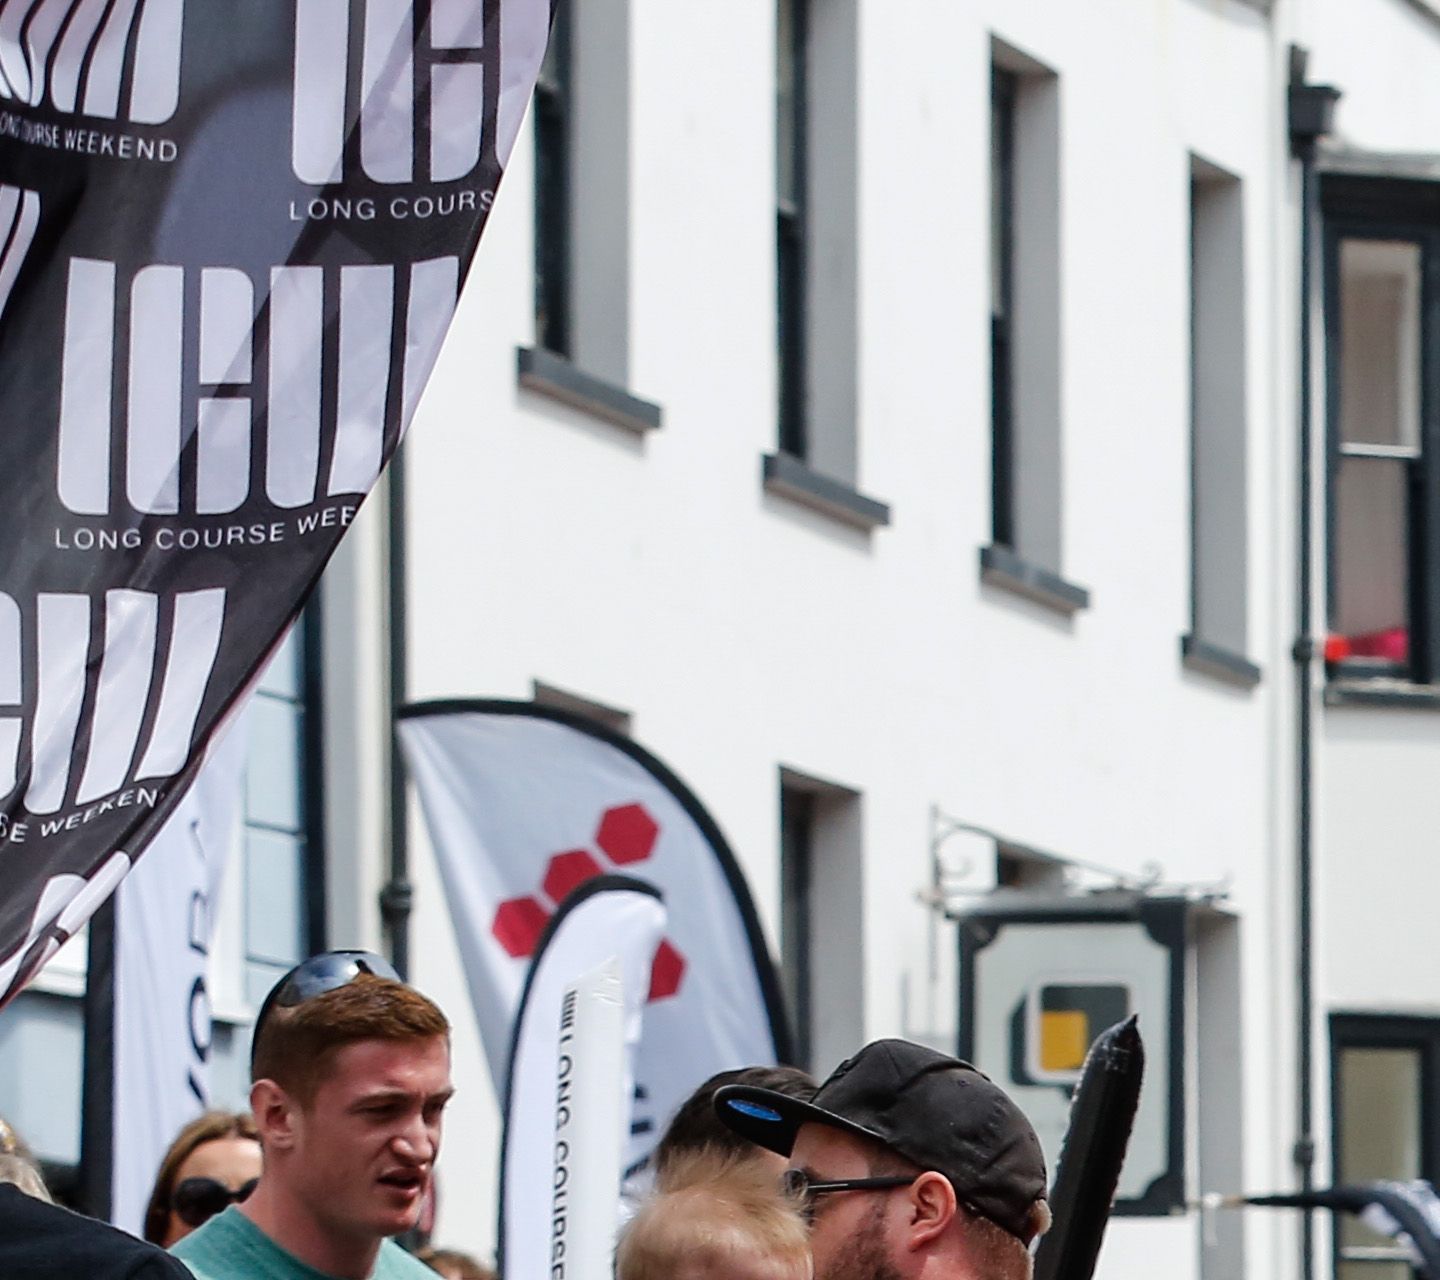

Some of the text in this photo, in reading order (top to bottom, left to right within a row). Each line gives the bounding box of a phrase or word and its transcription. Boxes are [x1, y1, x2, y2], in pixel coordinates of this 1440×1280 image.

[65, 128, 179, 163] WEEKEND
[290, 198, 377, 222] LONG
[55, 527, 142, 552] LONG
[154, 522, 286, 552] COURSE
[40, 785, 166, 840] WEEKEN
